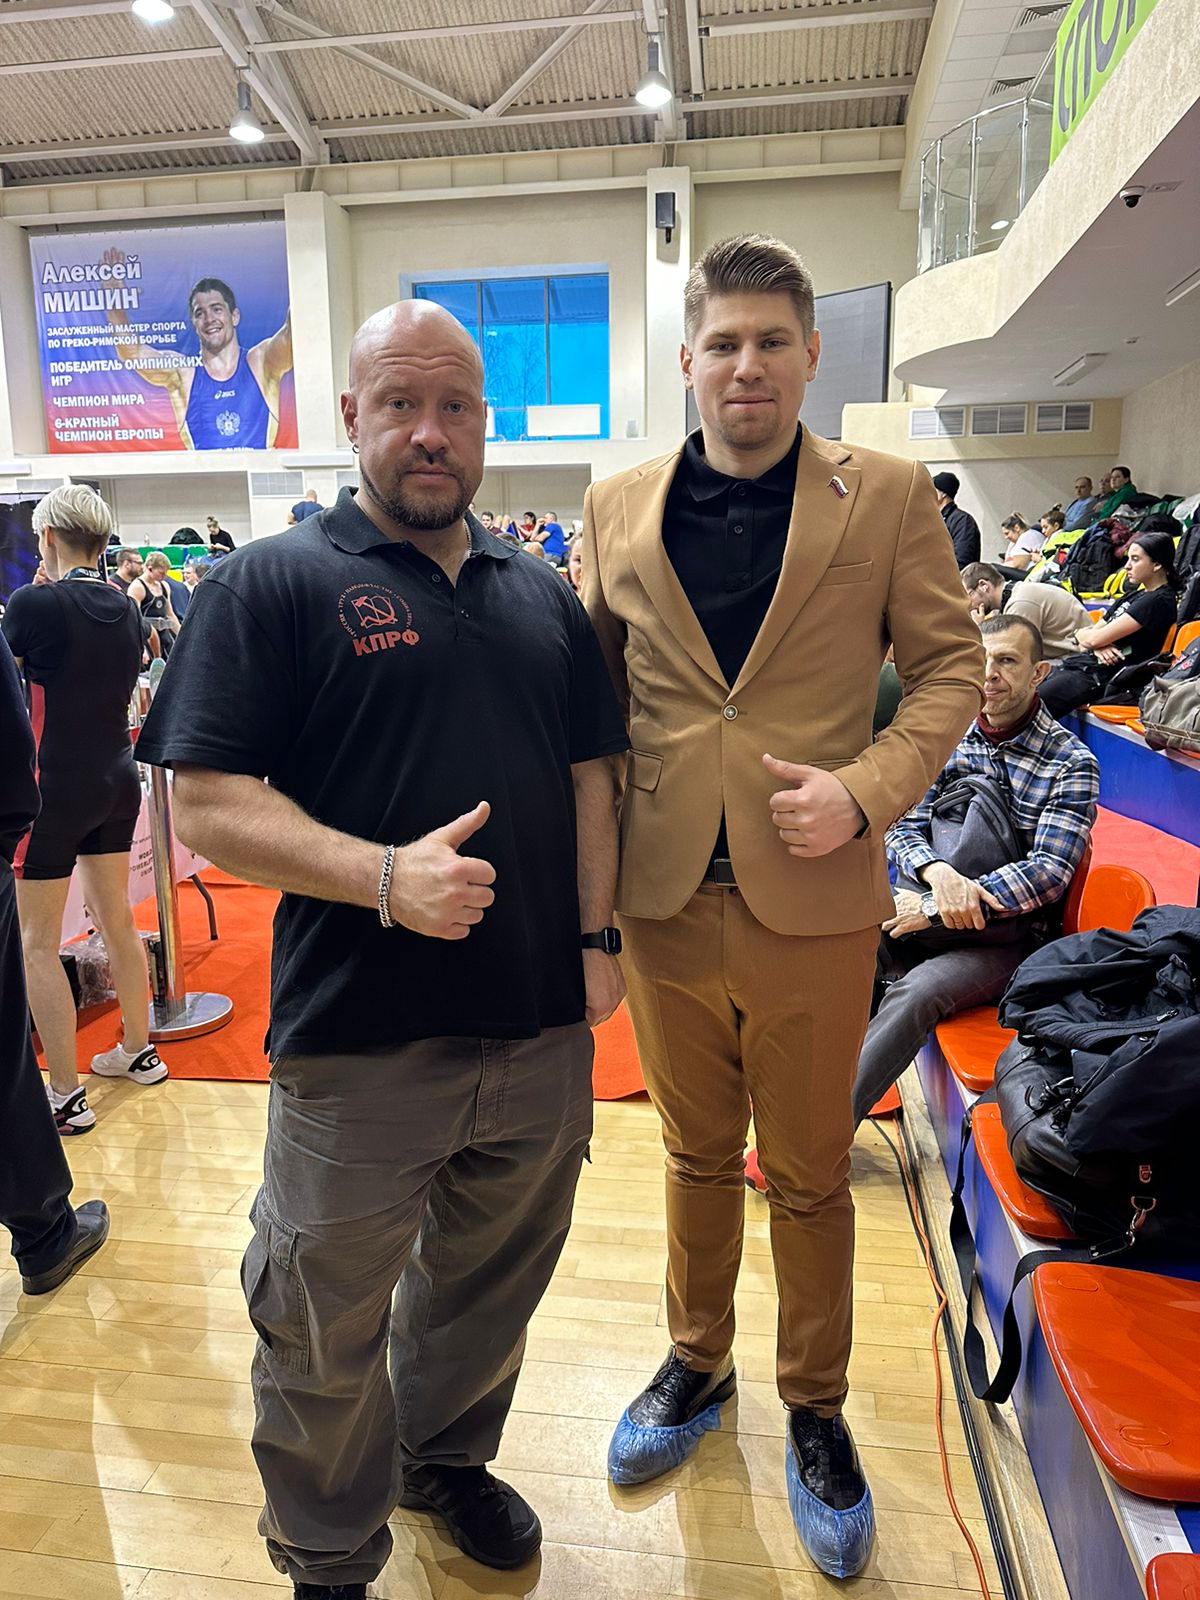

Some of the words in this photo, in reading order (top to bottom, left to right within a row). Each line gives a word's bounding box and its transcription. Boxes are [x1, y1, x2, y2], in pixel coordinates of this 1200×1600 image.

[42, 255, 141, 284] Алексей
[43, 287, 139, 314] МИШИН
[47, 322, 114, 337] ЗАСЛУЖЕННЫЙ
[115, 323, 150, 333] МАСТЕР
[151, 321, 187, 331] СПОРТА
[48, 338, 60, 349] ПО
[62, 334, 138, 348] ГРЕКО-РИМСКОЙ
[140, 333, 177, 344] БОРЬБЕ
[50, 359, 123, 374] ПОБЕДИТЕЛЬ
[51, 375, 73, 387] ИГР
[53, 395, 110, 408] ЧЕМПИОН
[111, 393, 145, 406] МИРА
[55, 413, 120, 429] 6-КРАТНЫЙ
[55, 430, 113, 442] ЧЕМПИОН
[114, 428, 164, 441] ЕВРОПЫ
[352, 629, 420, 656] КПРФ
